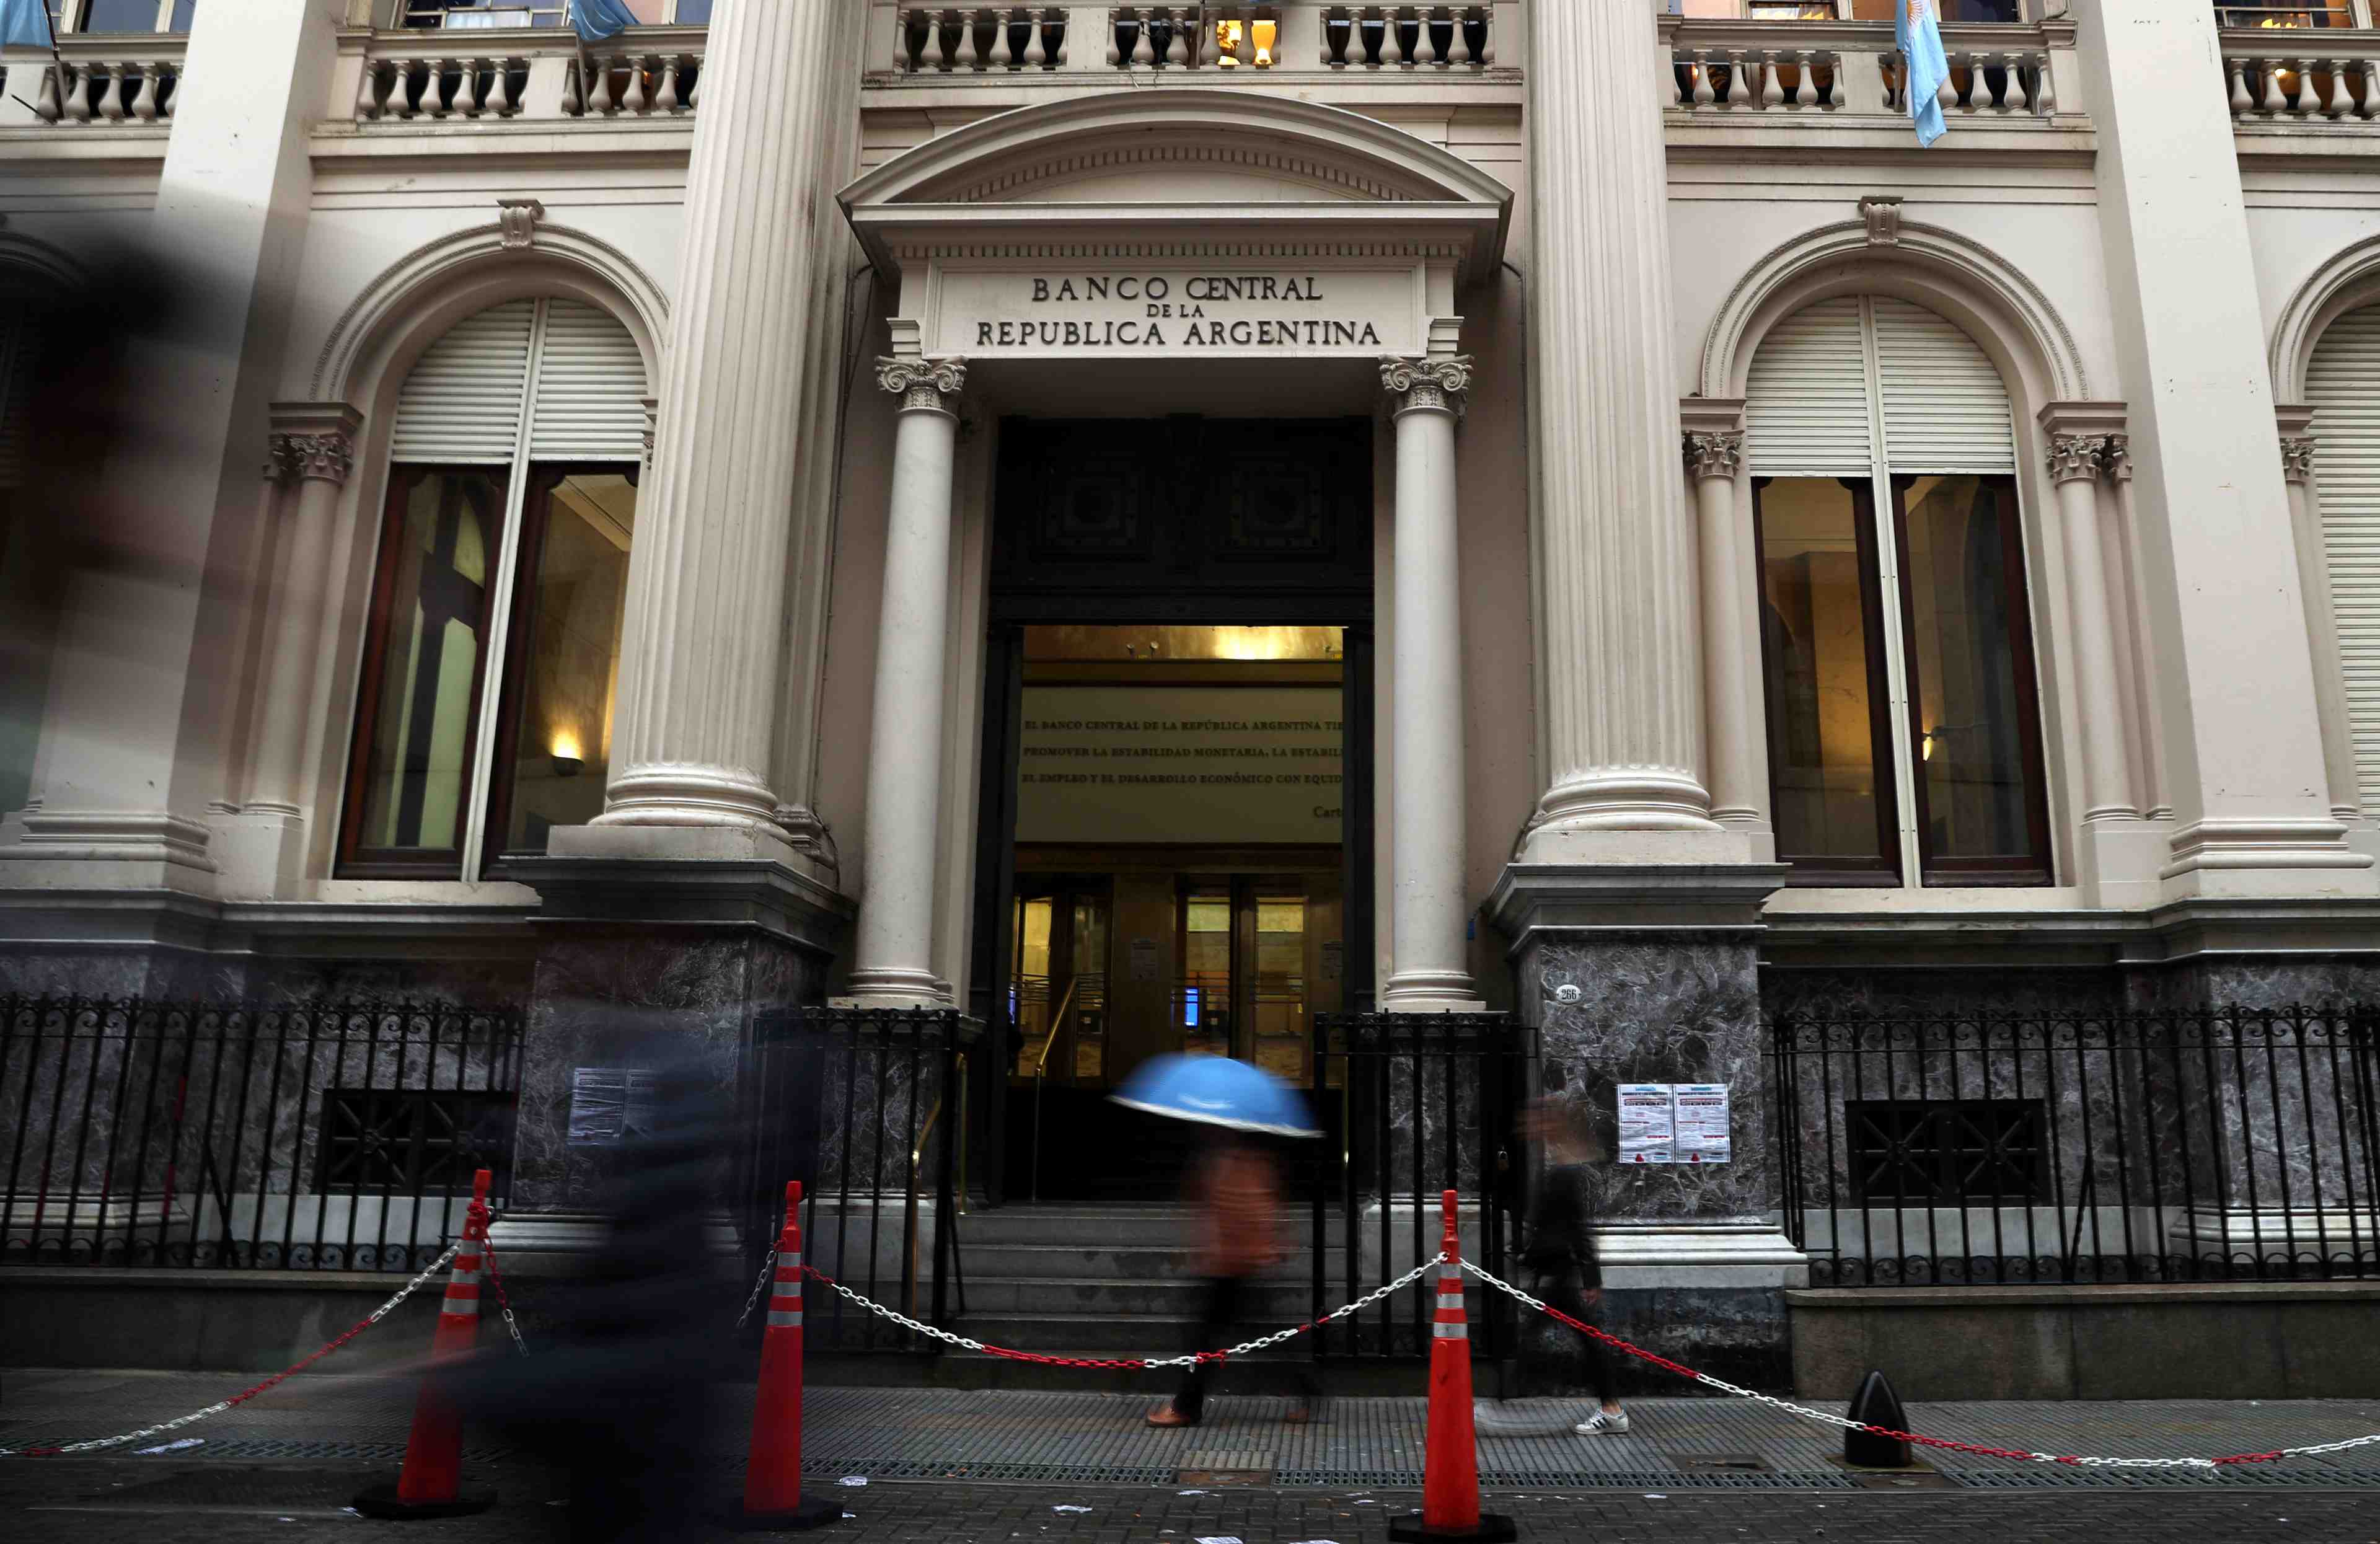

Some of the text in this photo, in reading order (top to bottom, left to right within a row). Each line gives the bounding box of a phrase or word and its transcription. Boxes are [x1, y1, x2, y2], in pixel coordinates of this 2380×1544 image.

[1032, 276, 1323, 302] BANCO CENTRAL
[1147, 303, 1205, 318] DE LA
[976, 320, 1382, 346] REPUBLICA ARGENTINA
[1025, 720, 1039, 730] EL
[1042, 720, 1082, 730] BANCO
[1085, 720, 1141, 730] CENTRAL
[1143, 721, 1159, 731] DE
[1162, 721, 1178, 731] LA
[1181, 718, 1248, 730] REPÚBLICA
[1252, 720, 1321, 730] ARGENTINA
[1023, 747, 1090, 757] PROMOVER
[1093, 748, 1108, 757] LA
[1111, 748, 1191, 757] ESTABILIDAD
[1194, 748, 1269, 758] MONETARIA,
[1272, 748, 1288, 757] LA
[1022, 774, 1036, 783] EL
[1039, 774, 1088, 783] EMPLEO
[1090, 774, 1098, 783] Y
[1101, 774, 1116, 783] EL
[1118, 774, 1197, 783] DESARROLLO
[1199, 771, 1272, 783] ECONÓMICO
[1276, 774, 1301, 783] CON
[1561, 989, 1577, 1000] 266
